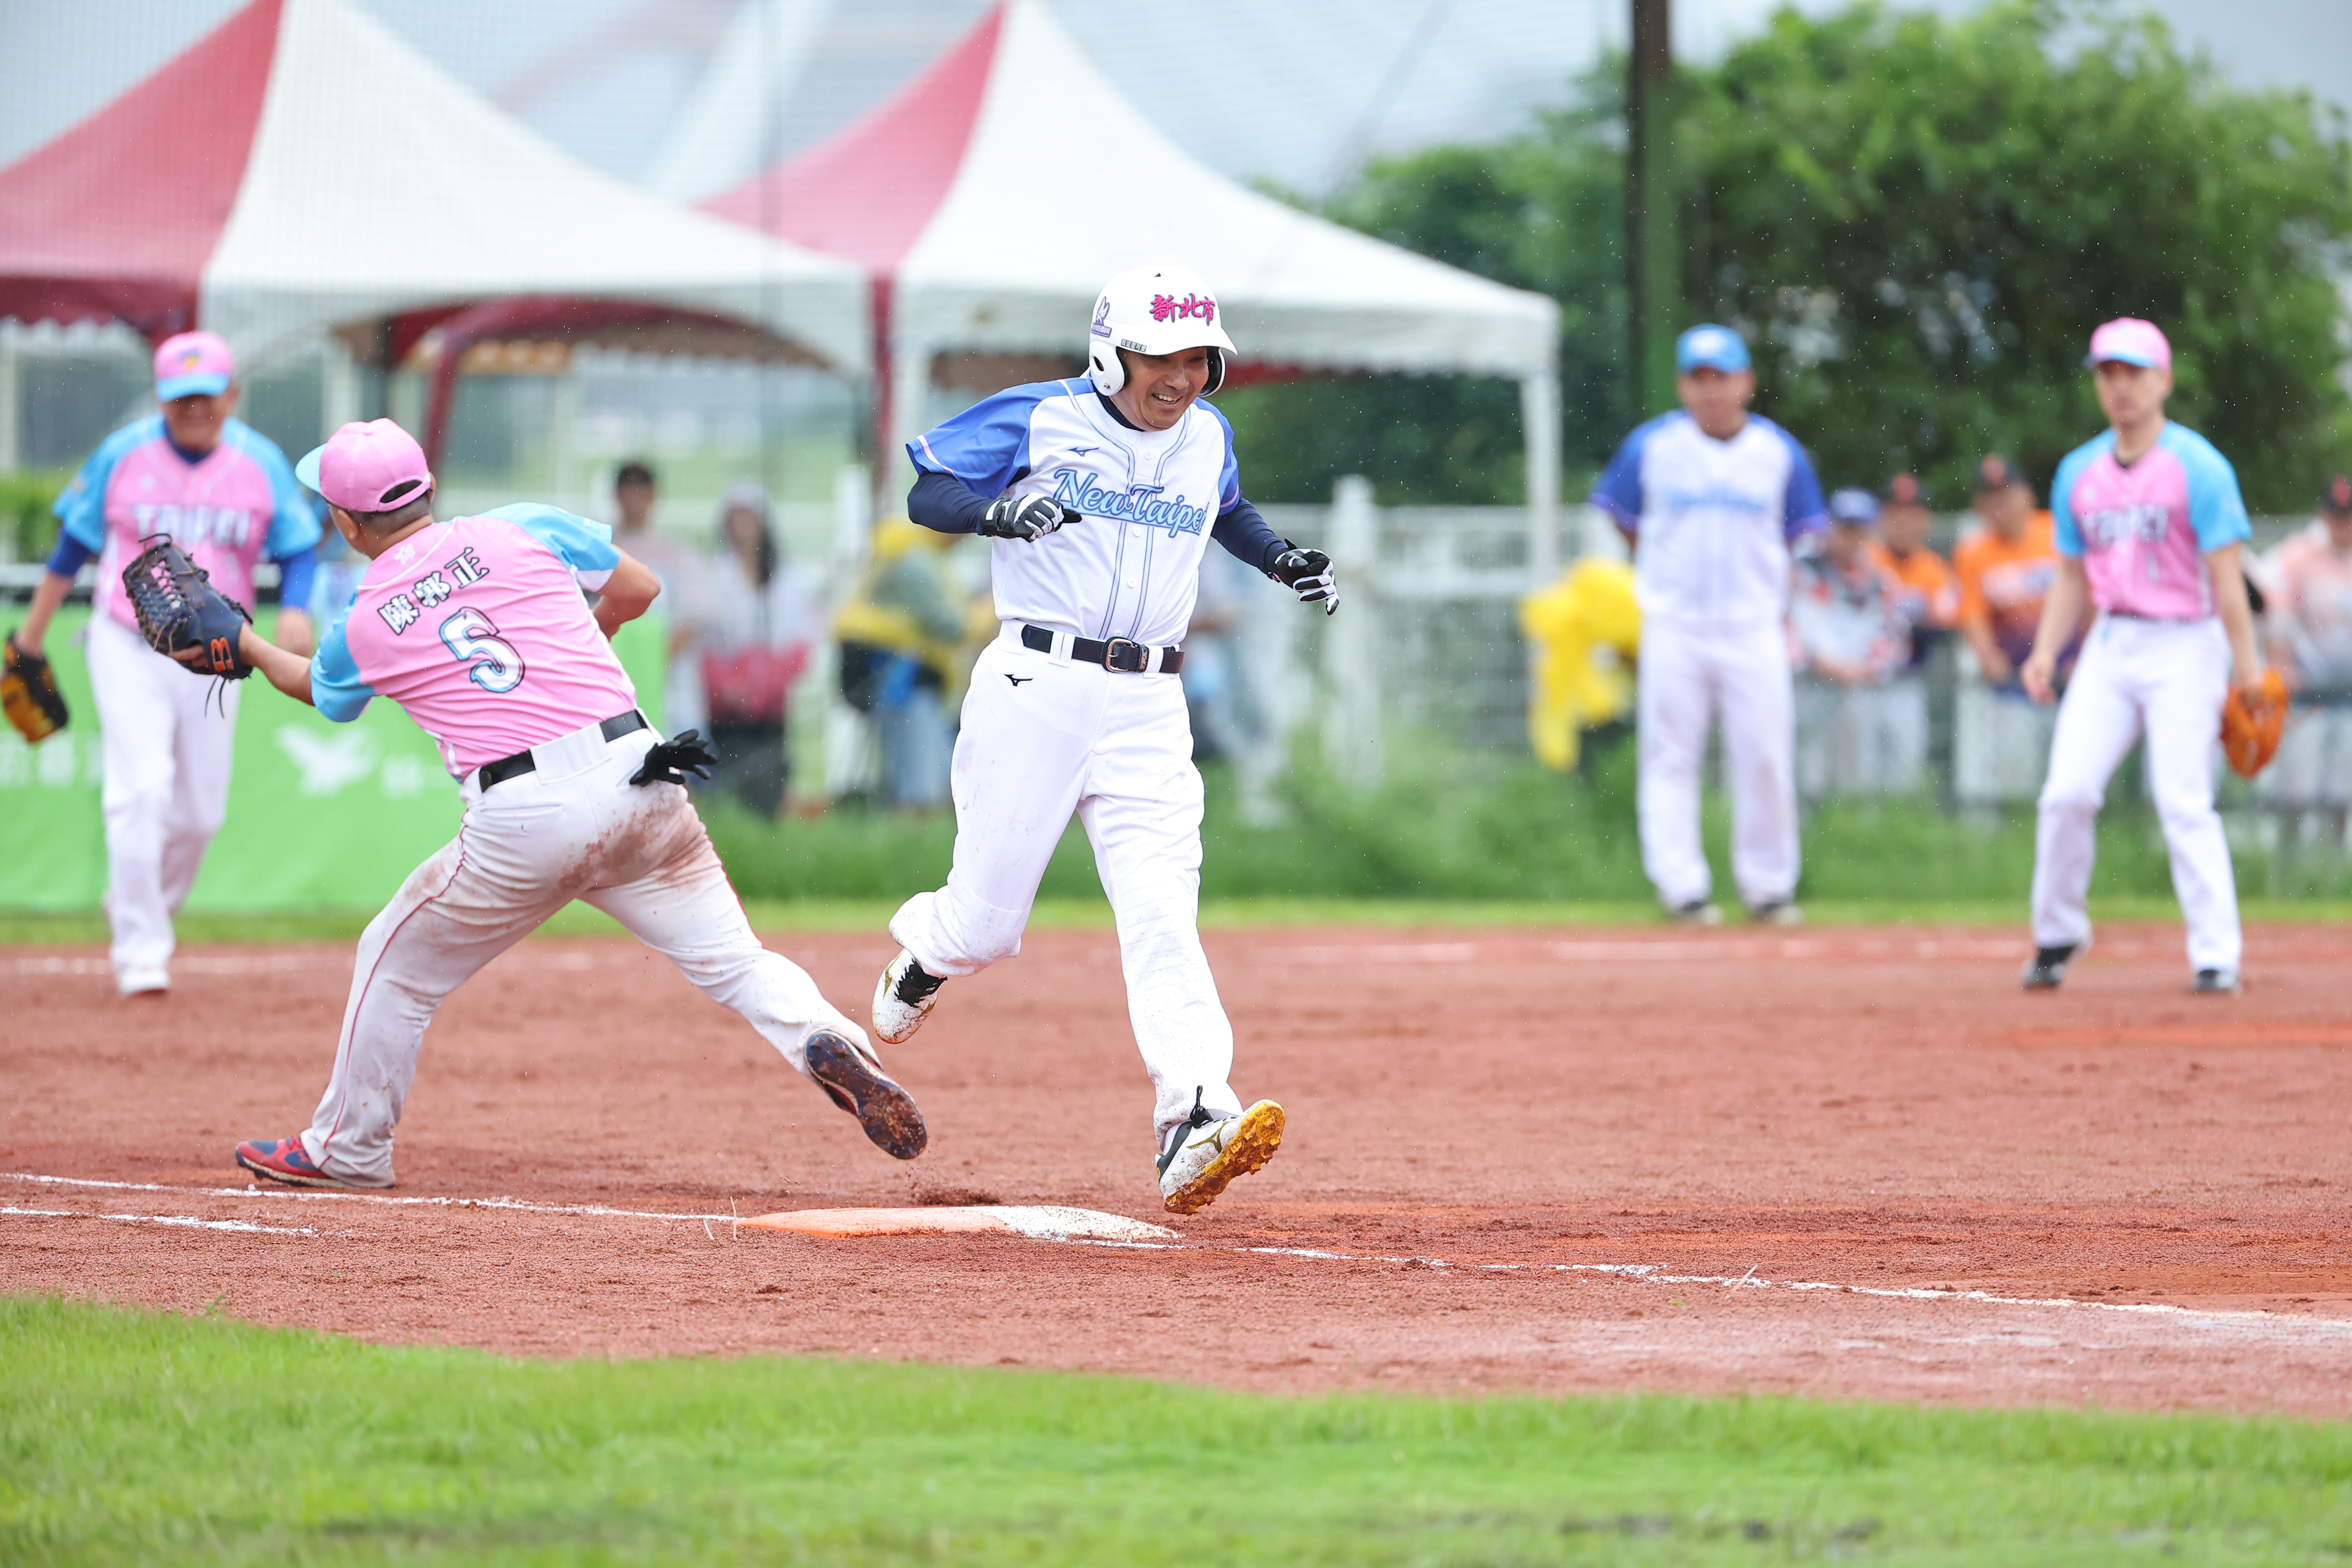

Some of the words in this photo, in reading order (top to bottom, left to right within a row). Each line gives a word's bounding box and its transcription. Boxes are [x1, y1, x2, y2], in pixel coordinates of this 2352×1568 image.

[1149, 293, 1215, 326] 新北市
[1121, 339, 1146, 352] 我這麼可愛
[439, 606, 526, 693] 5
